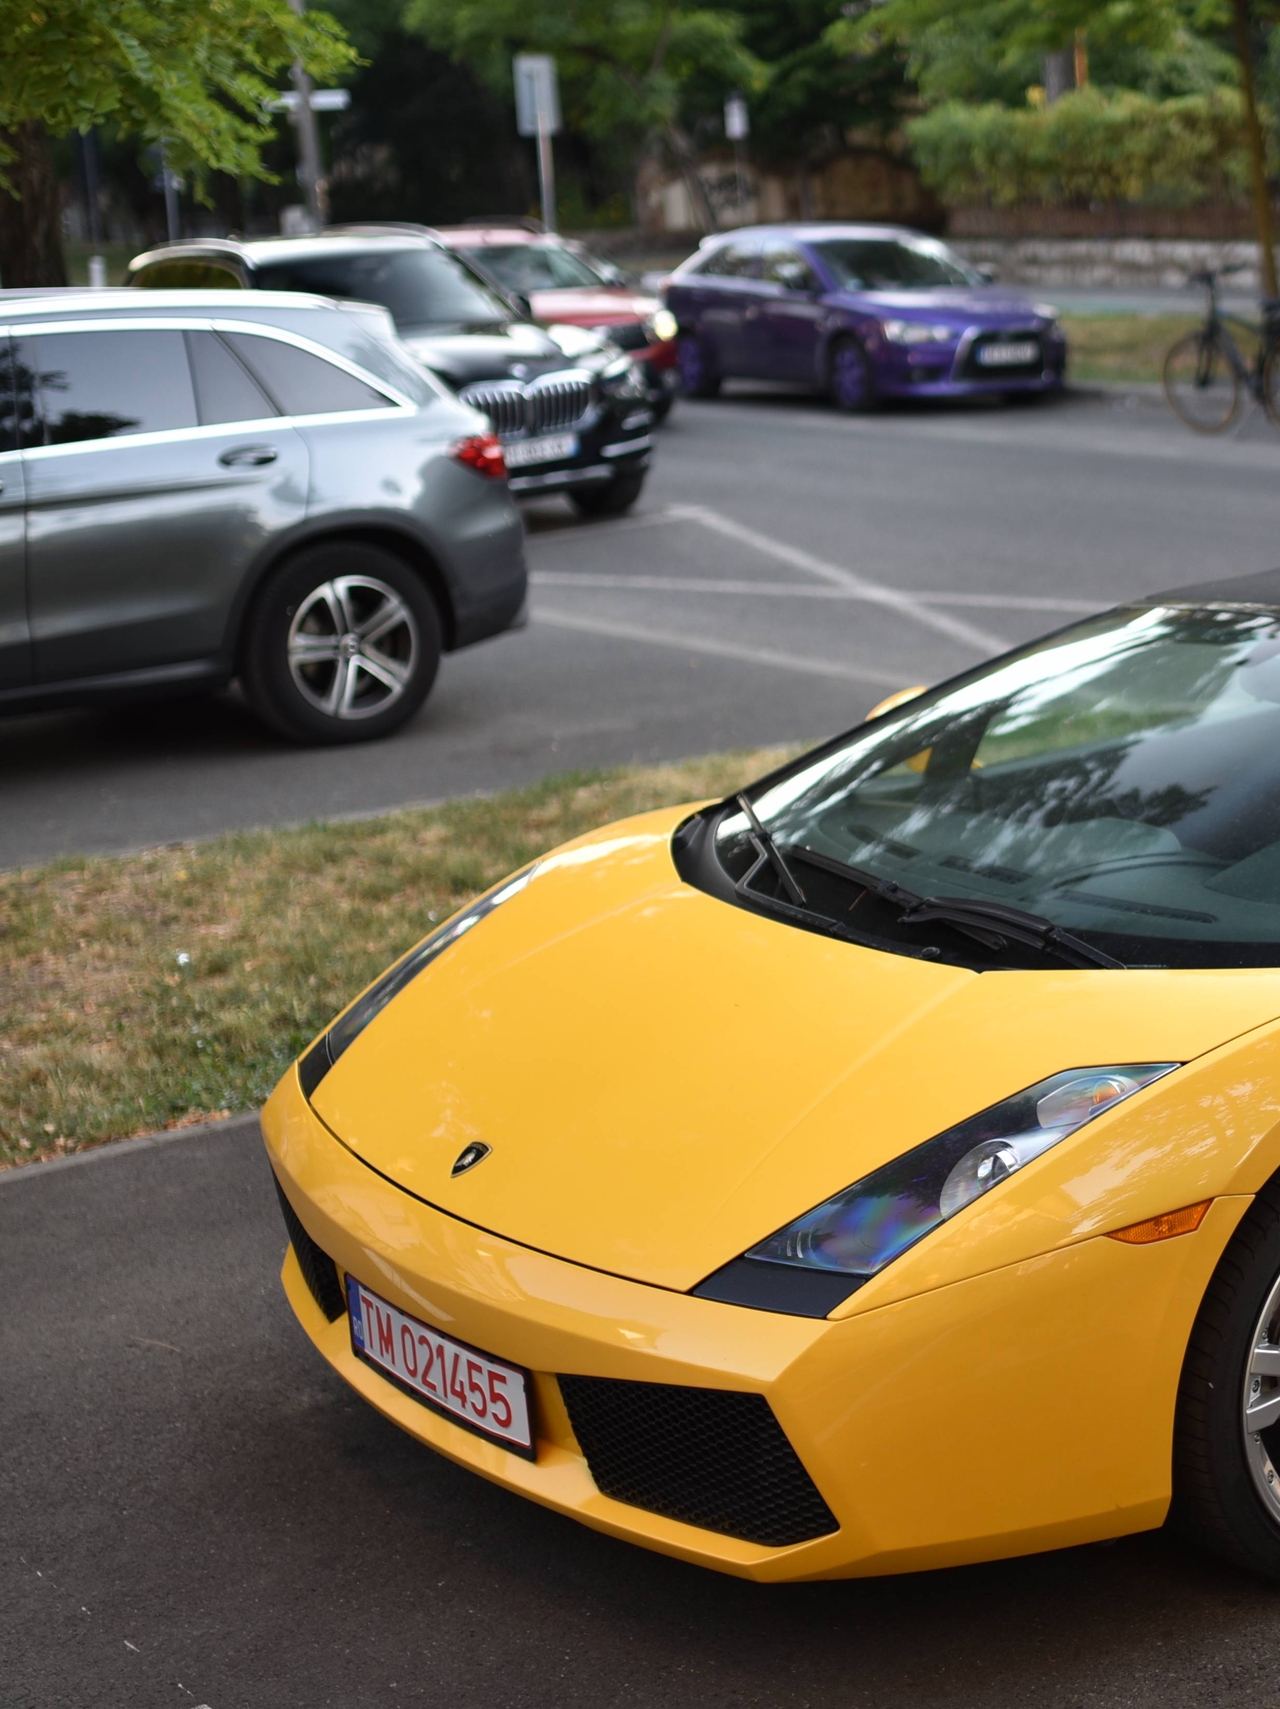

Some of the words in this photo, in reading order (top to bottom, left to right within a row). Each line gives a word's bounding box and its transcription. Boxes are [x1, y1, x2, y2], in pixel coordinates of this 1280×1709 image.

[352, 1315, 364, 1340] RO
[361, 1294, 396, 1367] TM
[400, 1323, 513, 1428] 021455
